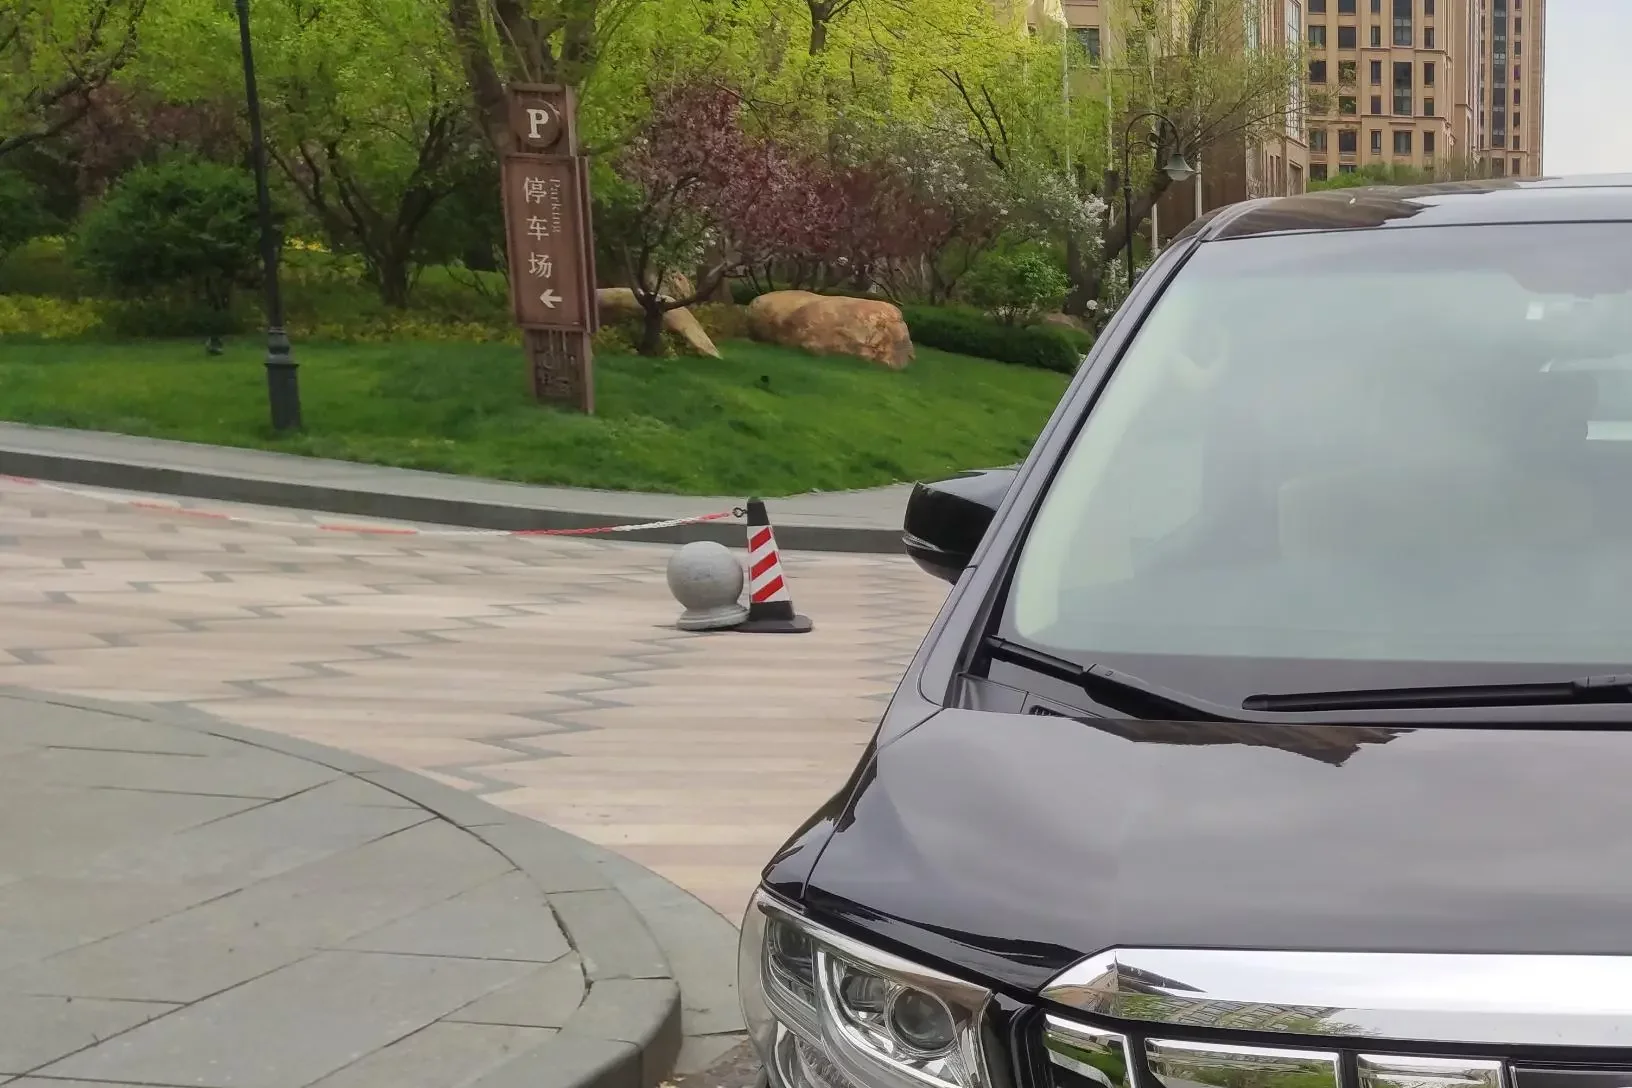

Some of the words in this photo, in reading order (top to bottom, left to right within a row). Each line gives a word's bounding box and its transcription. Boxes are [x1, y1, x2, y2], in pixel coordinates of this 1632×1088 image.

[528, 109, 549, 139] P
[523, 176, 552, 279] 停车场
[549, 179, 562, 233] Parking
